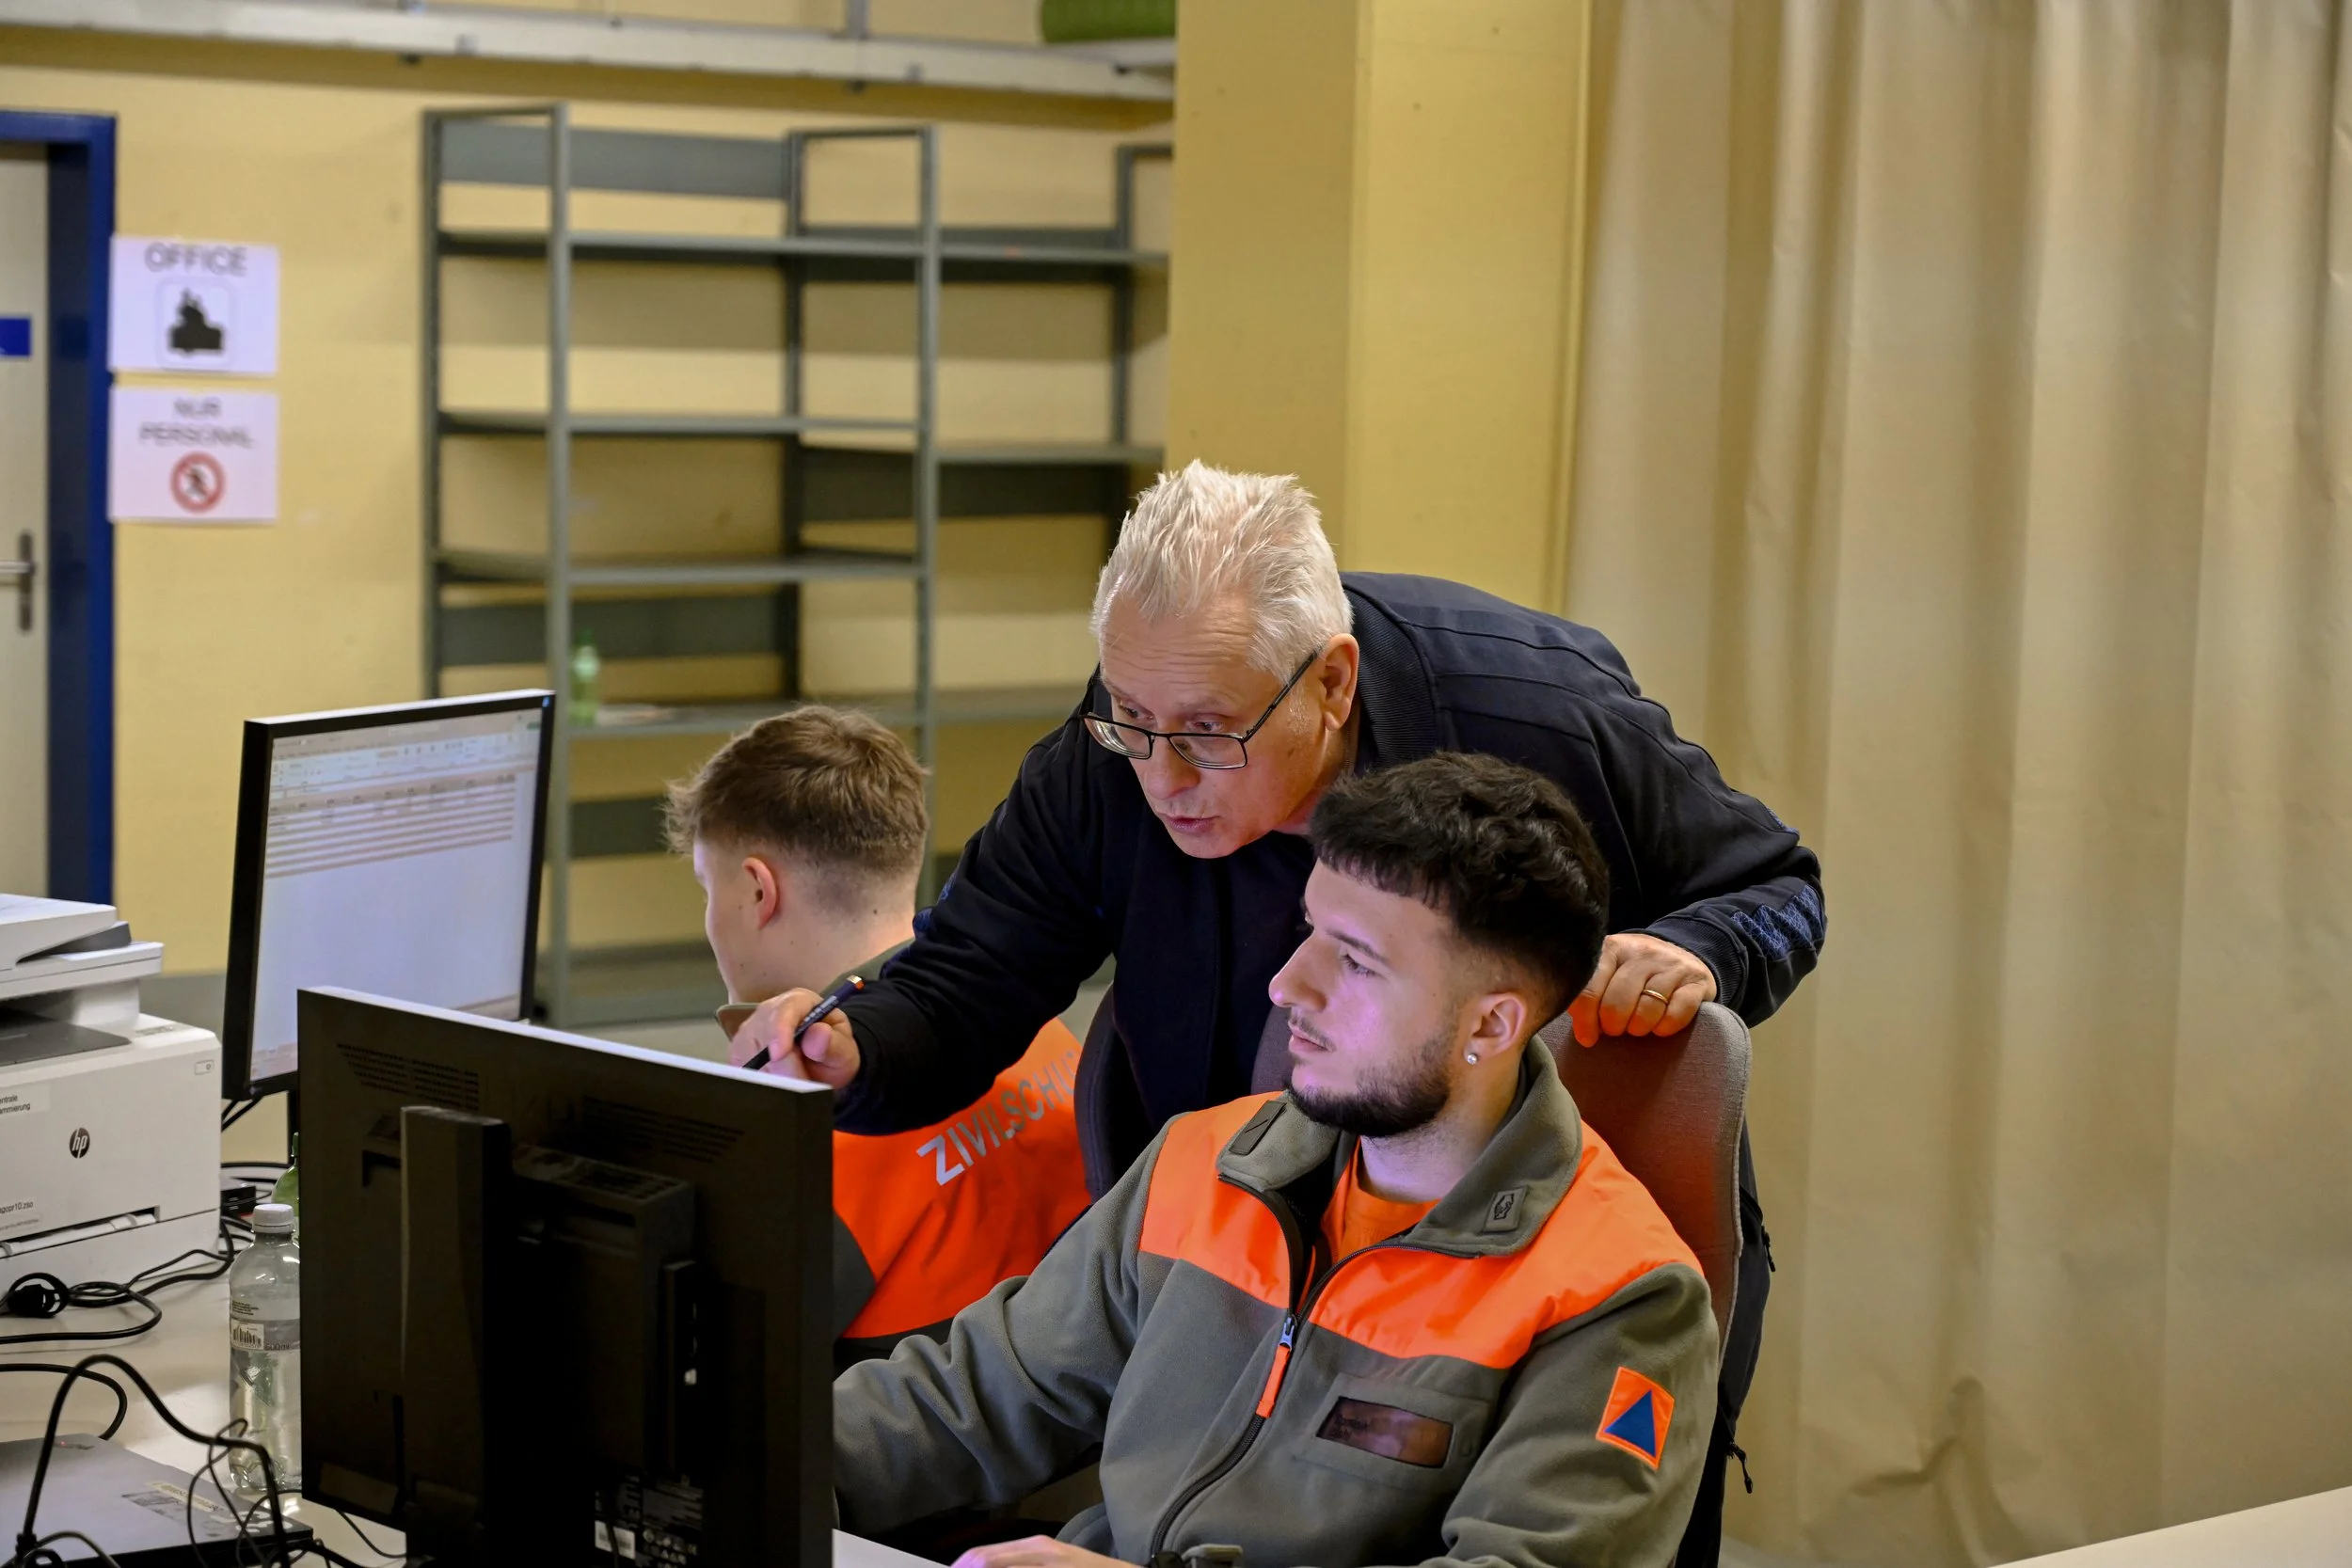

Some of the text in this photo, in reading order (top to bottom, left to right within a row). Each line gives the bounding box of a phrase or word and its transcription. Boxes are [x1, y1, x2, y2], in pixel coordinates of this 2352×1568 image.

[144, 242, 247, 277] OFFICE
[916, 1050, 1074, 1185] ZIVILSCHU
[70, 1127, 90, 1159] hp
